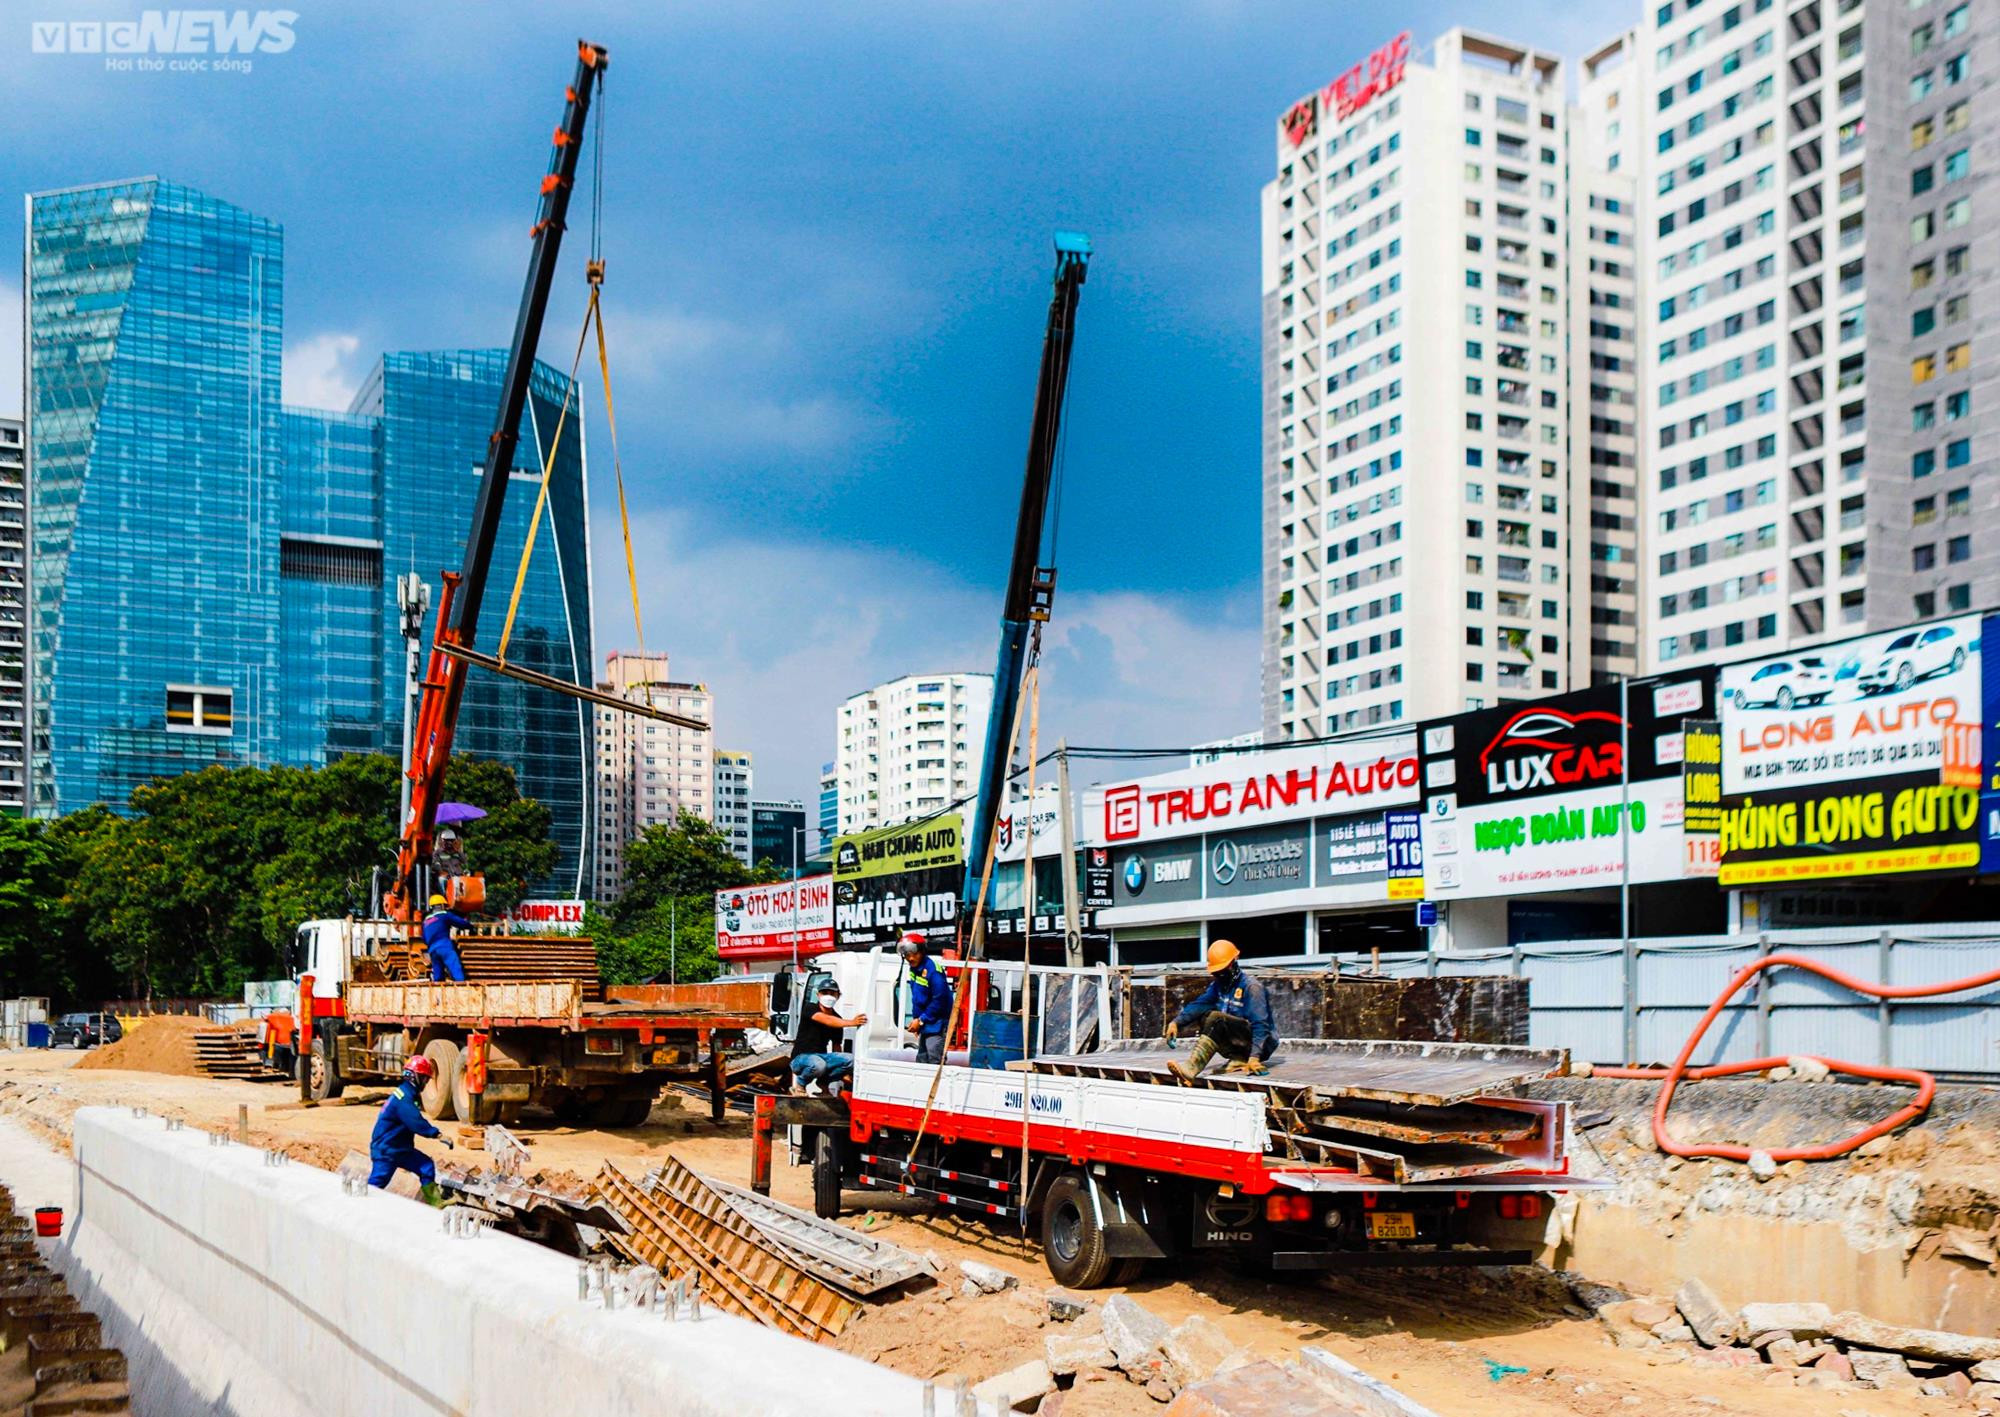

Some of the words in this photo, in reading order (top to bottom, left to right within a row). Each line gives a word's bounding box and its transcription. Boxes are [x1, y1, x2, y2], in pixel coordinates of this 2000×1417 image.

[1740, 714, 1835, 753] LONG
[1850, 696, 1959, 739] AUTO
[1487, 742, 1624, 794] LUXCAR
[1239, 765, 1318, 813] ANH
[1325, 756, 1420, 800] Auto
[1686, 773, 1720, 803] LONG
[1592, 800, 1647, 838] AUTO
[1804, 792, 1885, 845] LONG
[1890, 783, 1980, 842] AUTO
[925, 828, 956, 851] AUTO
[1390, 824, 1419, 840] AUTO
[1239, 839, 1303, 865] Mercedes
[1388, 841, 1422, 866] 116
[1153, 858, 1193, 883] BMW
[511, 904, 582, 922] COMPLEX
[836, 895, 874, 930] PHÁT
[876, 891, 906, 931] LỘC
[908, 891, 956, 923] AUTO
[1087, 898, 1113, 906] CENTER
[1207, 1231, 1252, 1242] HINO
